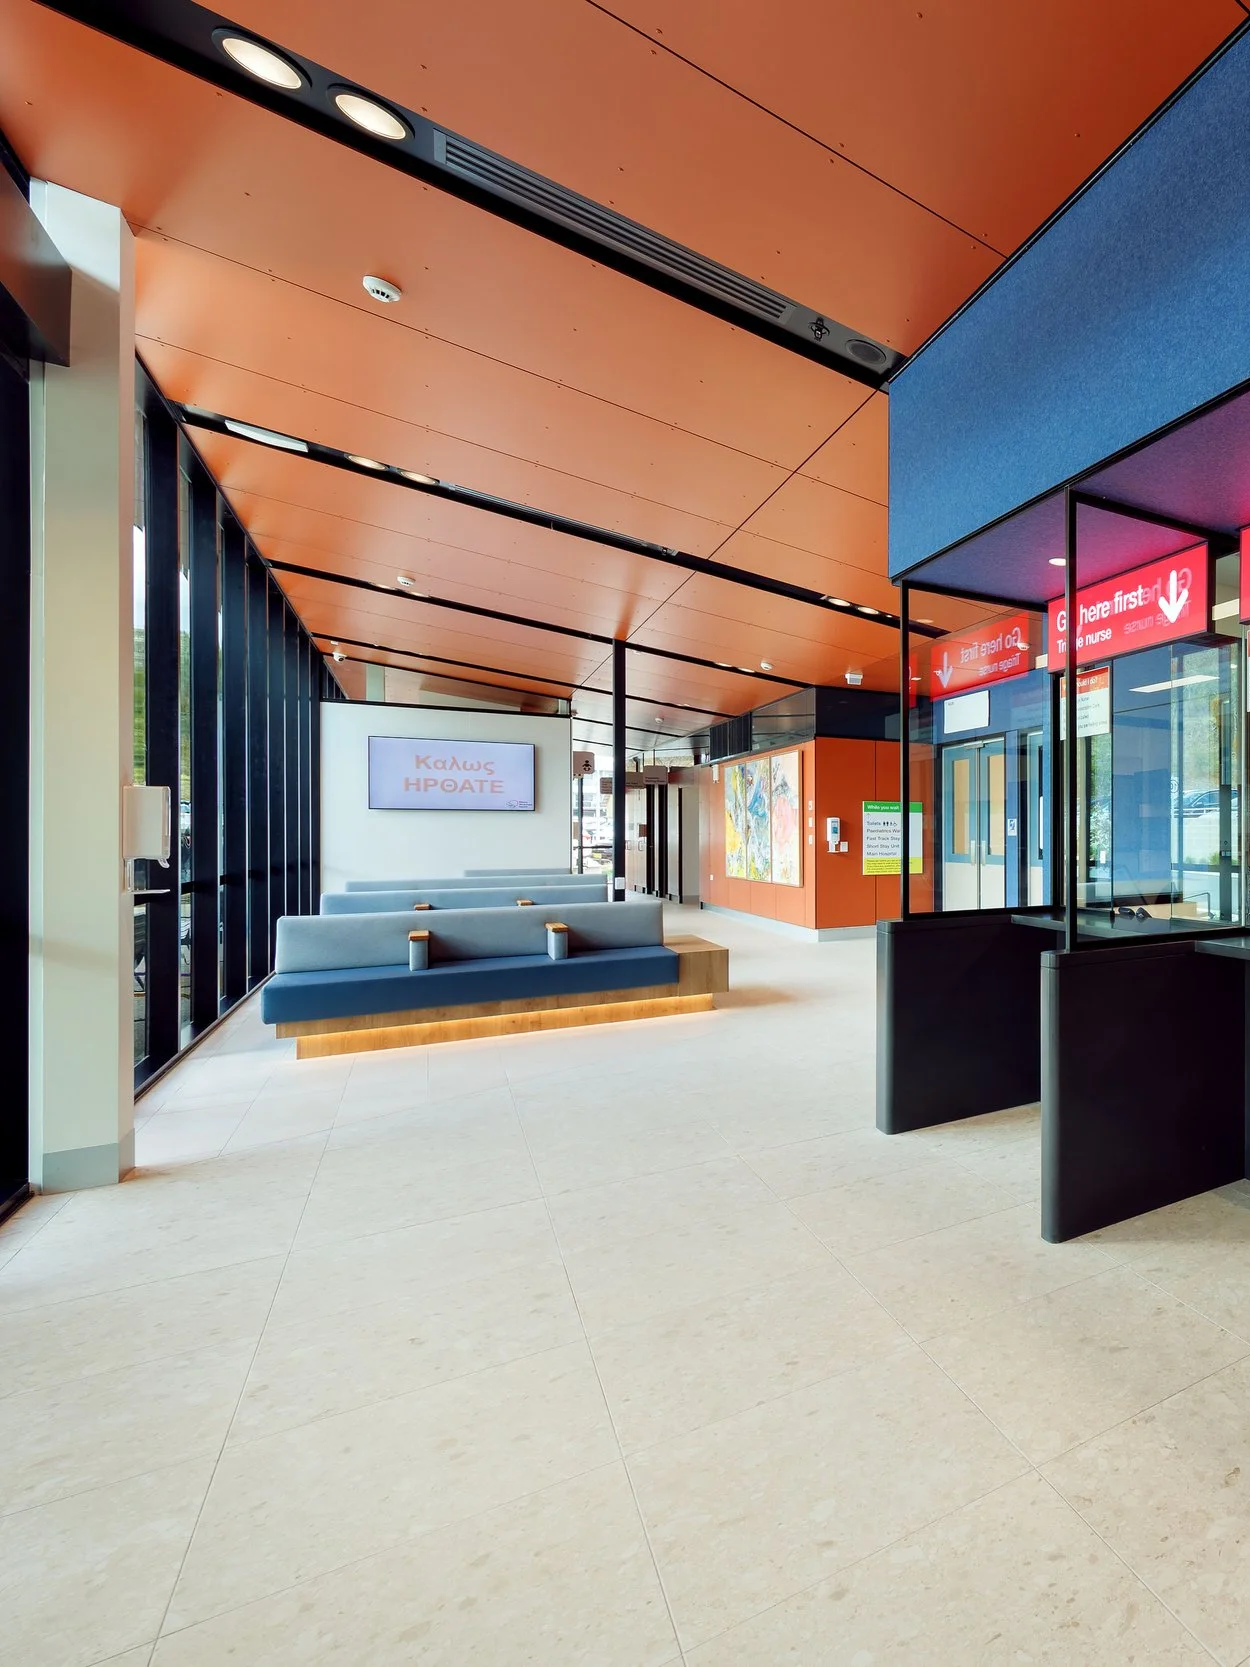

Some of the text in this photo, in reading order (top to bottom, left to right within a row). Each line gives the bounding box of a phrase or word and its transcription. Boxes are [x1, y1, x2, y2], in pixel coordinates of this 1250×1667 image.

[1079, 601, 1110, 626] here
[1114, 584, 1144, 615] first
[1085, 627, 1112, 646] nurse
[414, 754, 495, 776] Καλως
